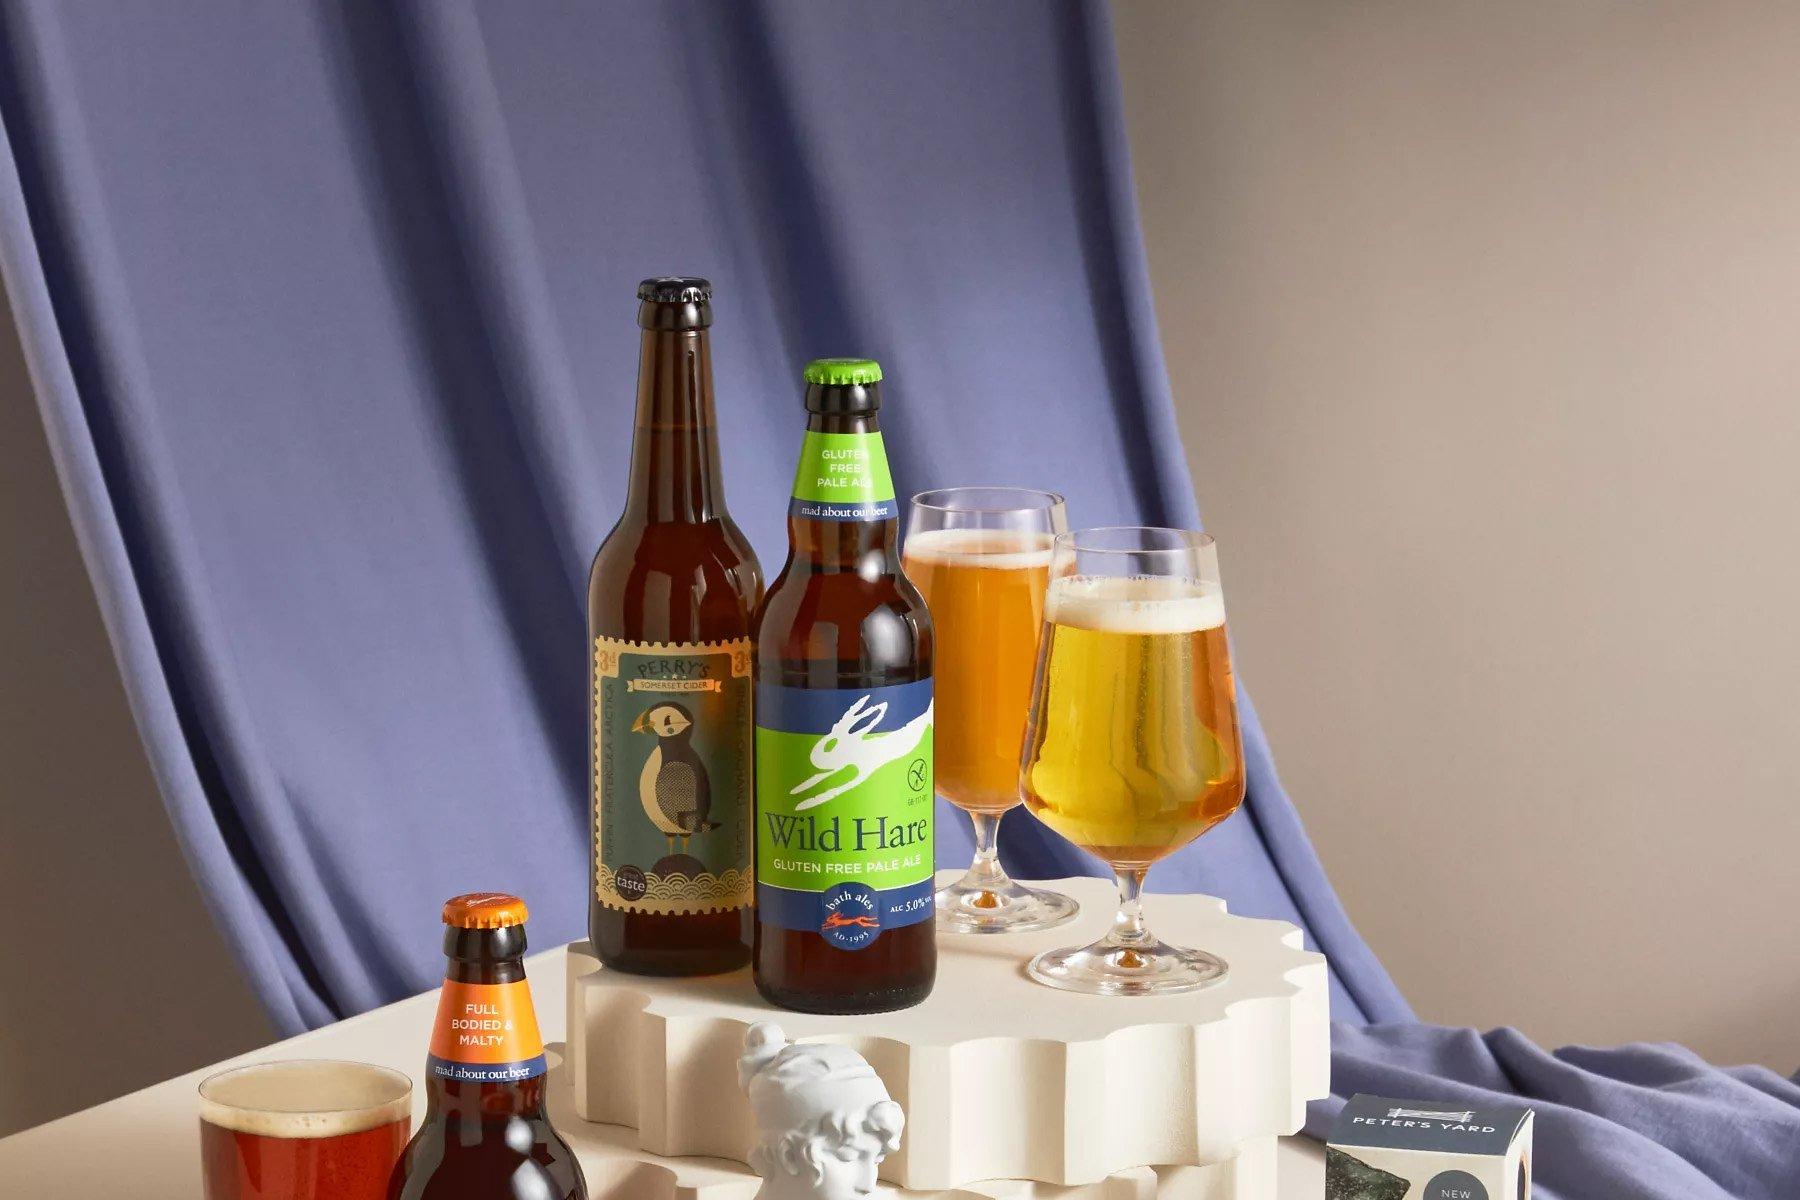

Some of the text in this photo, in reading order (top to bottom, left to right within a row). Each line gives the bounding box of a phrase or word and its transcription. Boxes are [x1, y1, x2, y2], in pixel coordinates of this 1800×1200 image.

[830, 463, 862, 473] FREE
[817, 477, 848, 487] PALE
[801, 506, 821, 517] mad
[822, 505, 851, 518] about
[871, 506, 888, 516] beer
[637, 659, 711, 679] PERRY'S
[641, 681, 708, 690] SOMERSET CIDER
[765, 812, 927, 852] Wild Hare
[773, 854, 921, 874] GLUTEN FREE PALE ALE
[617, 876, 645, 892] taste
[825, 890, 874, 911] bath ales
[890, 904, 904, 913] ALC
[905, 897, 925, 912] 5.0%
[466, 1004, 498, 1014] FULL
[452, 1019, 513, 1030] BODIED &
[459, 1035, 504, 1045] MALTY
[435, 1065, 530, 1079] mad about our beer
[1353, 1117, 1496, 1134] PETER'S YARD
[1441, 1189, 1471, 1199] NEW
